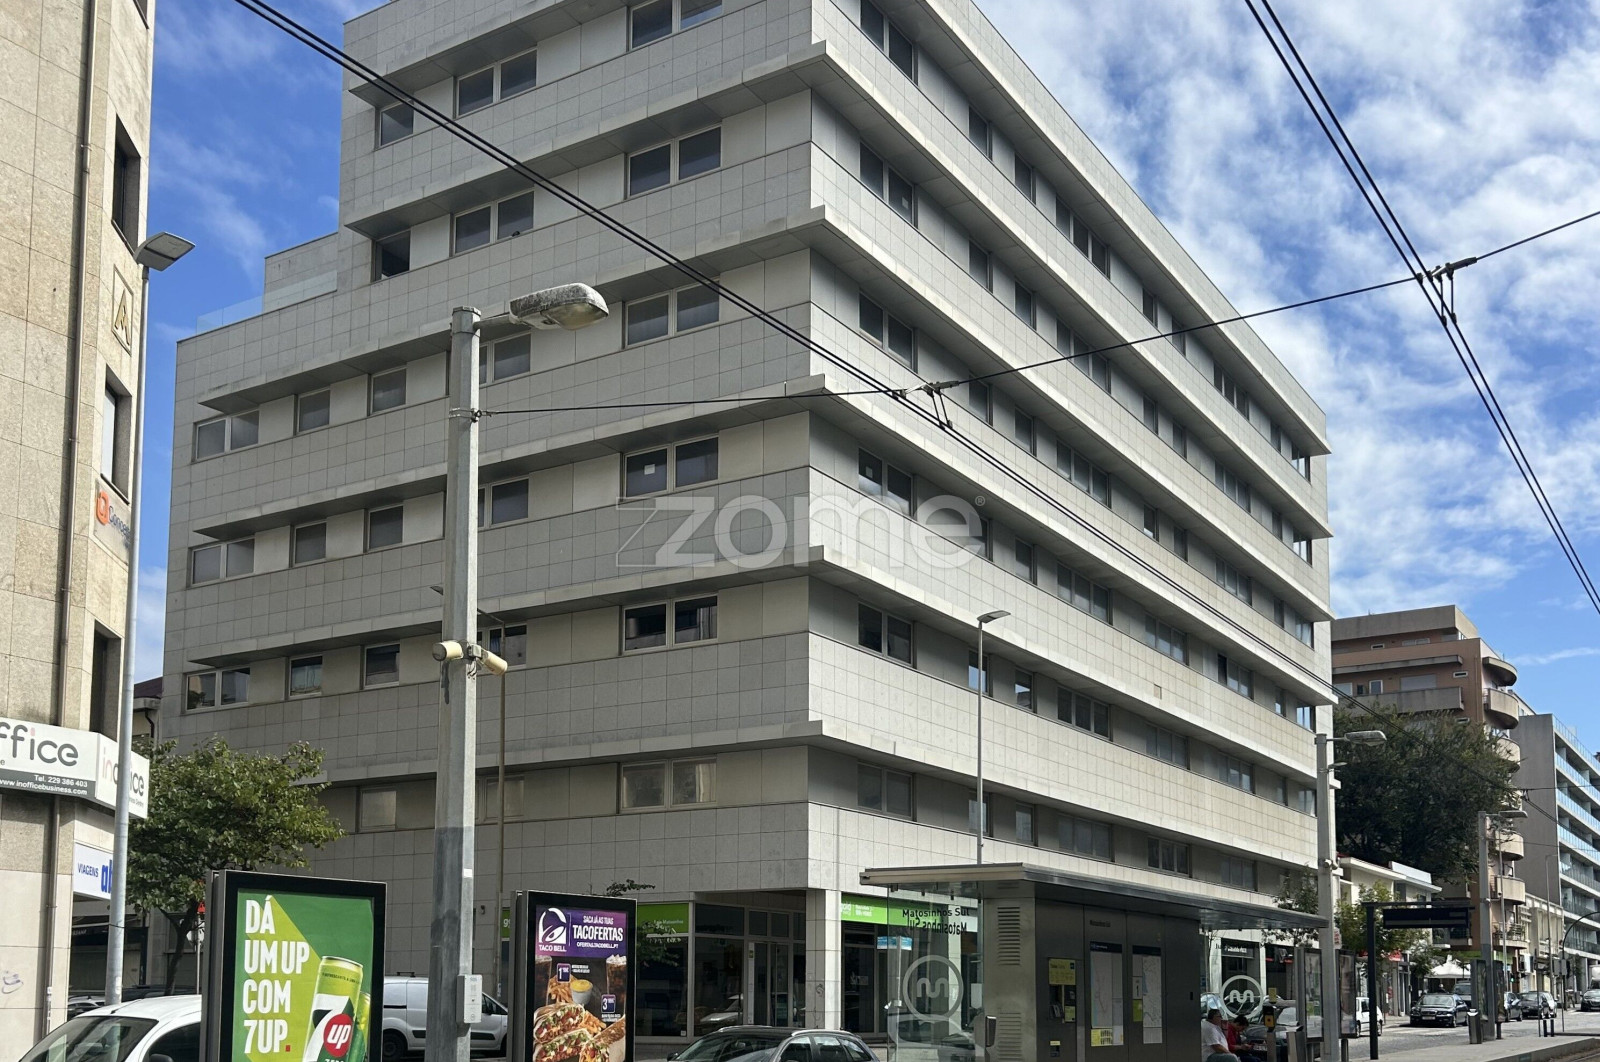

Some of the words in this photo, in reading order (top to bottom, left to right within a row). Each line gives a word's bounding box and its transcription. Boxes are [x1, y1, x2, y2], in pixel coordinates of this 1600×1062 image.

[48, 776, 61, 784] 229
[75, 780, 88, 788] 403
[77, 862, 99, 878] VIAGENS
[245, 894, 276, 935] DÁ
[902, 908, 953, 919] Matosinhos
[954, 907, 970, 917] Sul
[572, 925, 624, 942] TACOFERTAS
[538, 944, 553, 952] TACO
[244, 939, 278, 974] UM
[281, 940, 310, 975] UP
[242, 978, 291, 1015] COM
[243, 1019, 291, 1054] 7UP.
